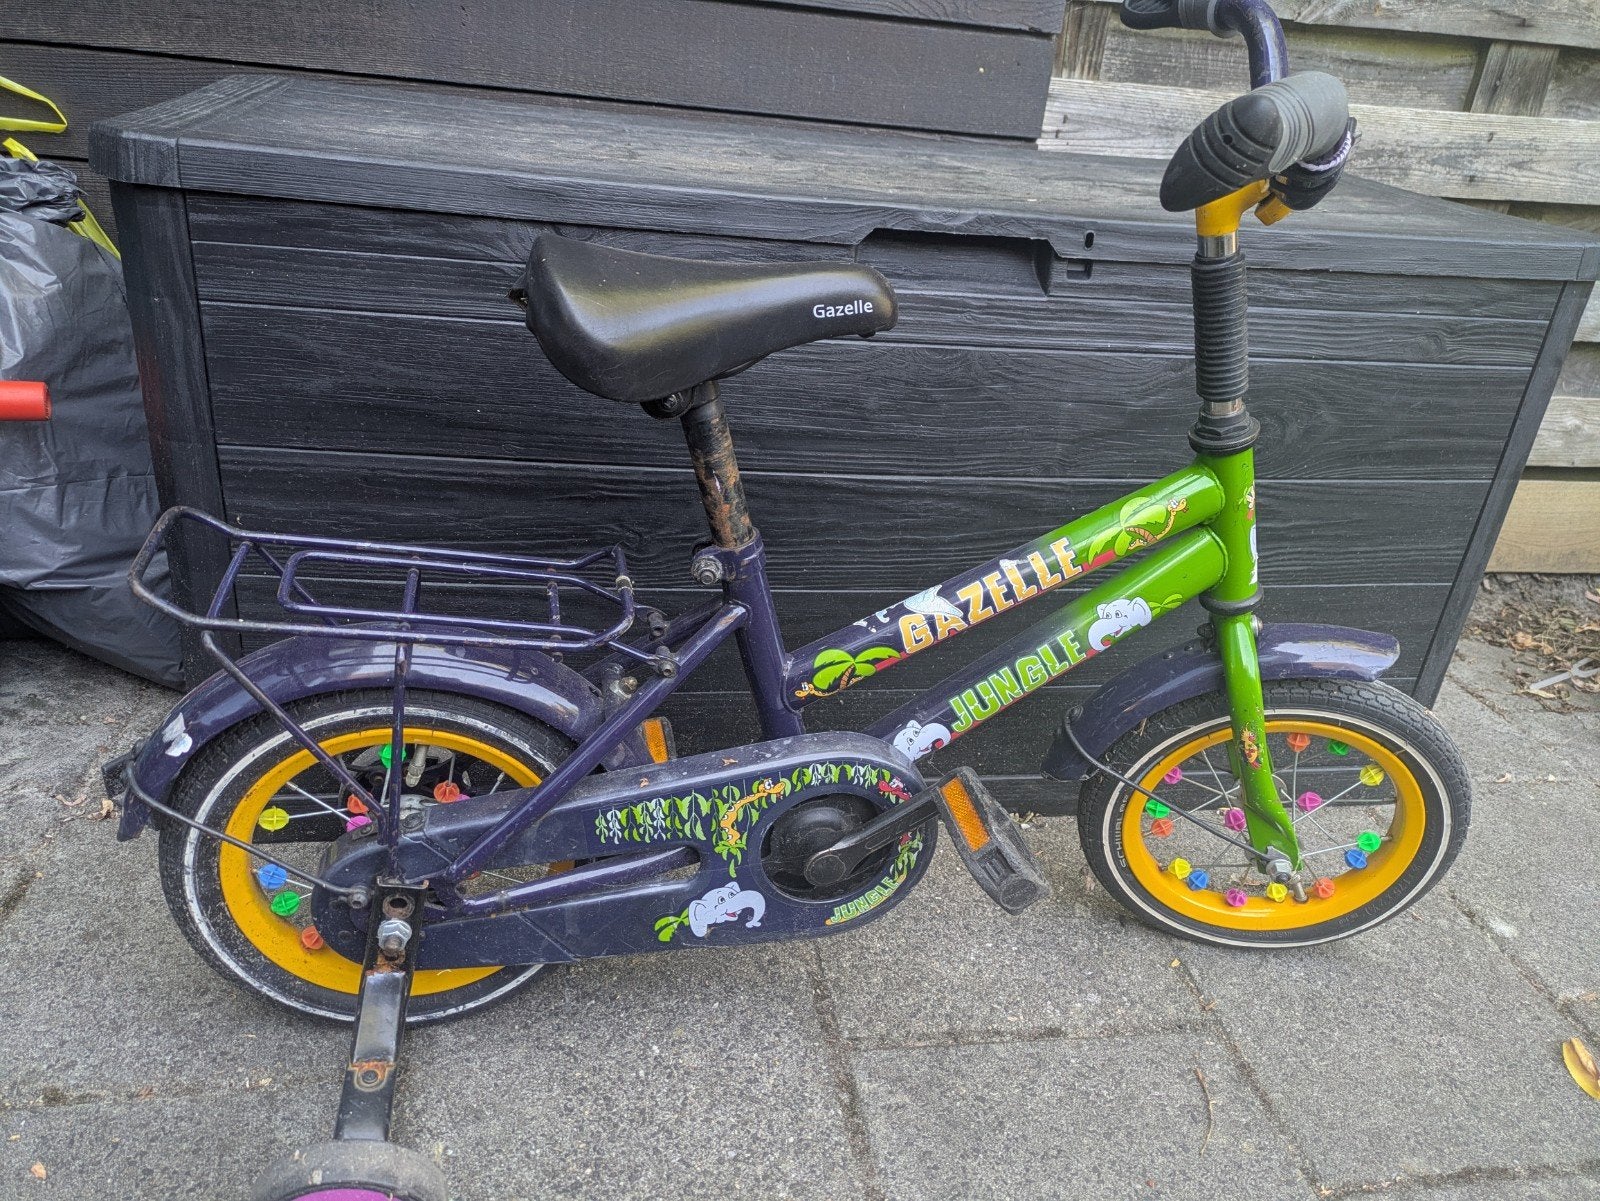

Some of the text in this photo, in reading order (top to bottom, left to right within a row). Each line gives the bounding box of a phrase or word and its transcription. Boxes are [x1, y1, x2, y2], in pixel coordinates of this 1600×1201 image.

[813, 299, 874, 318] Gazelle
[899, 537, 1083, 654] GAZELLE
[949, 630, 1087, 733] JUNGLE
[830, 876, 900, 923] JUNGLE
